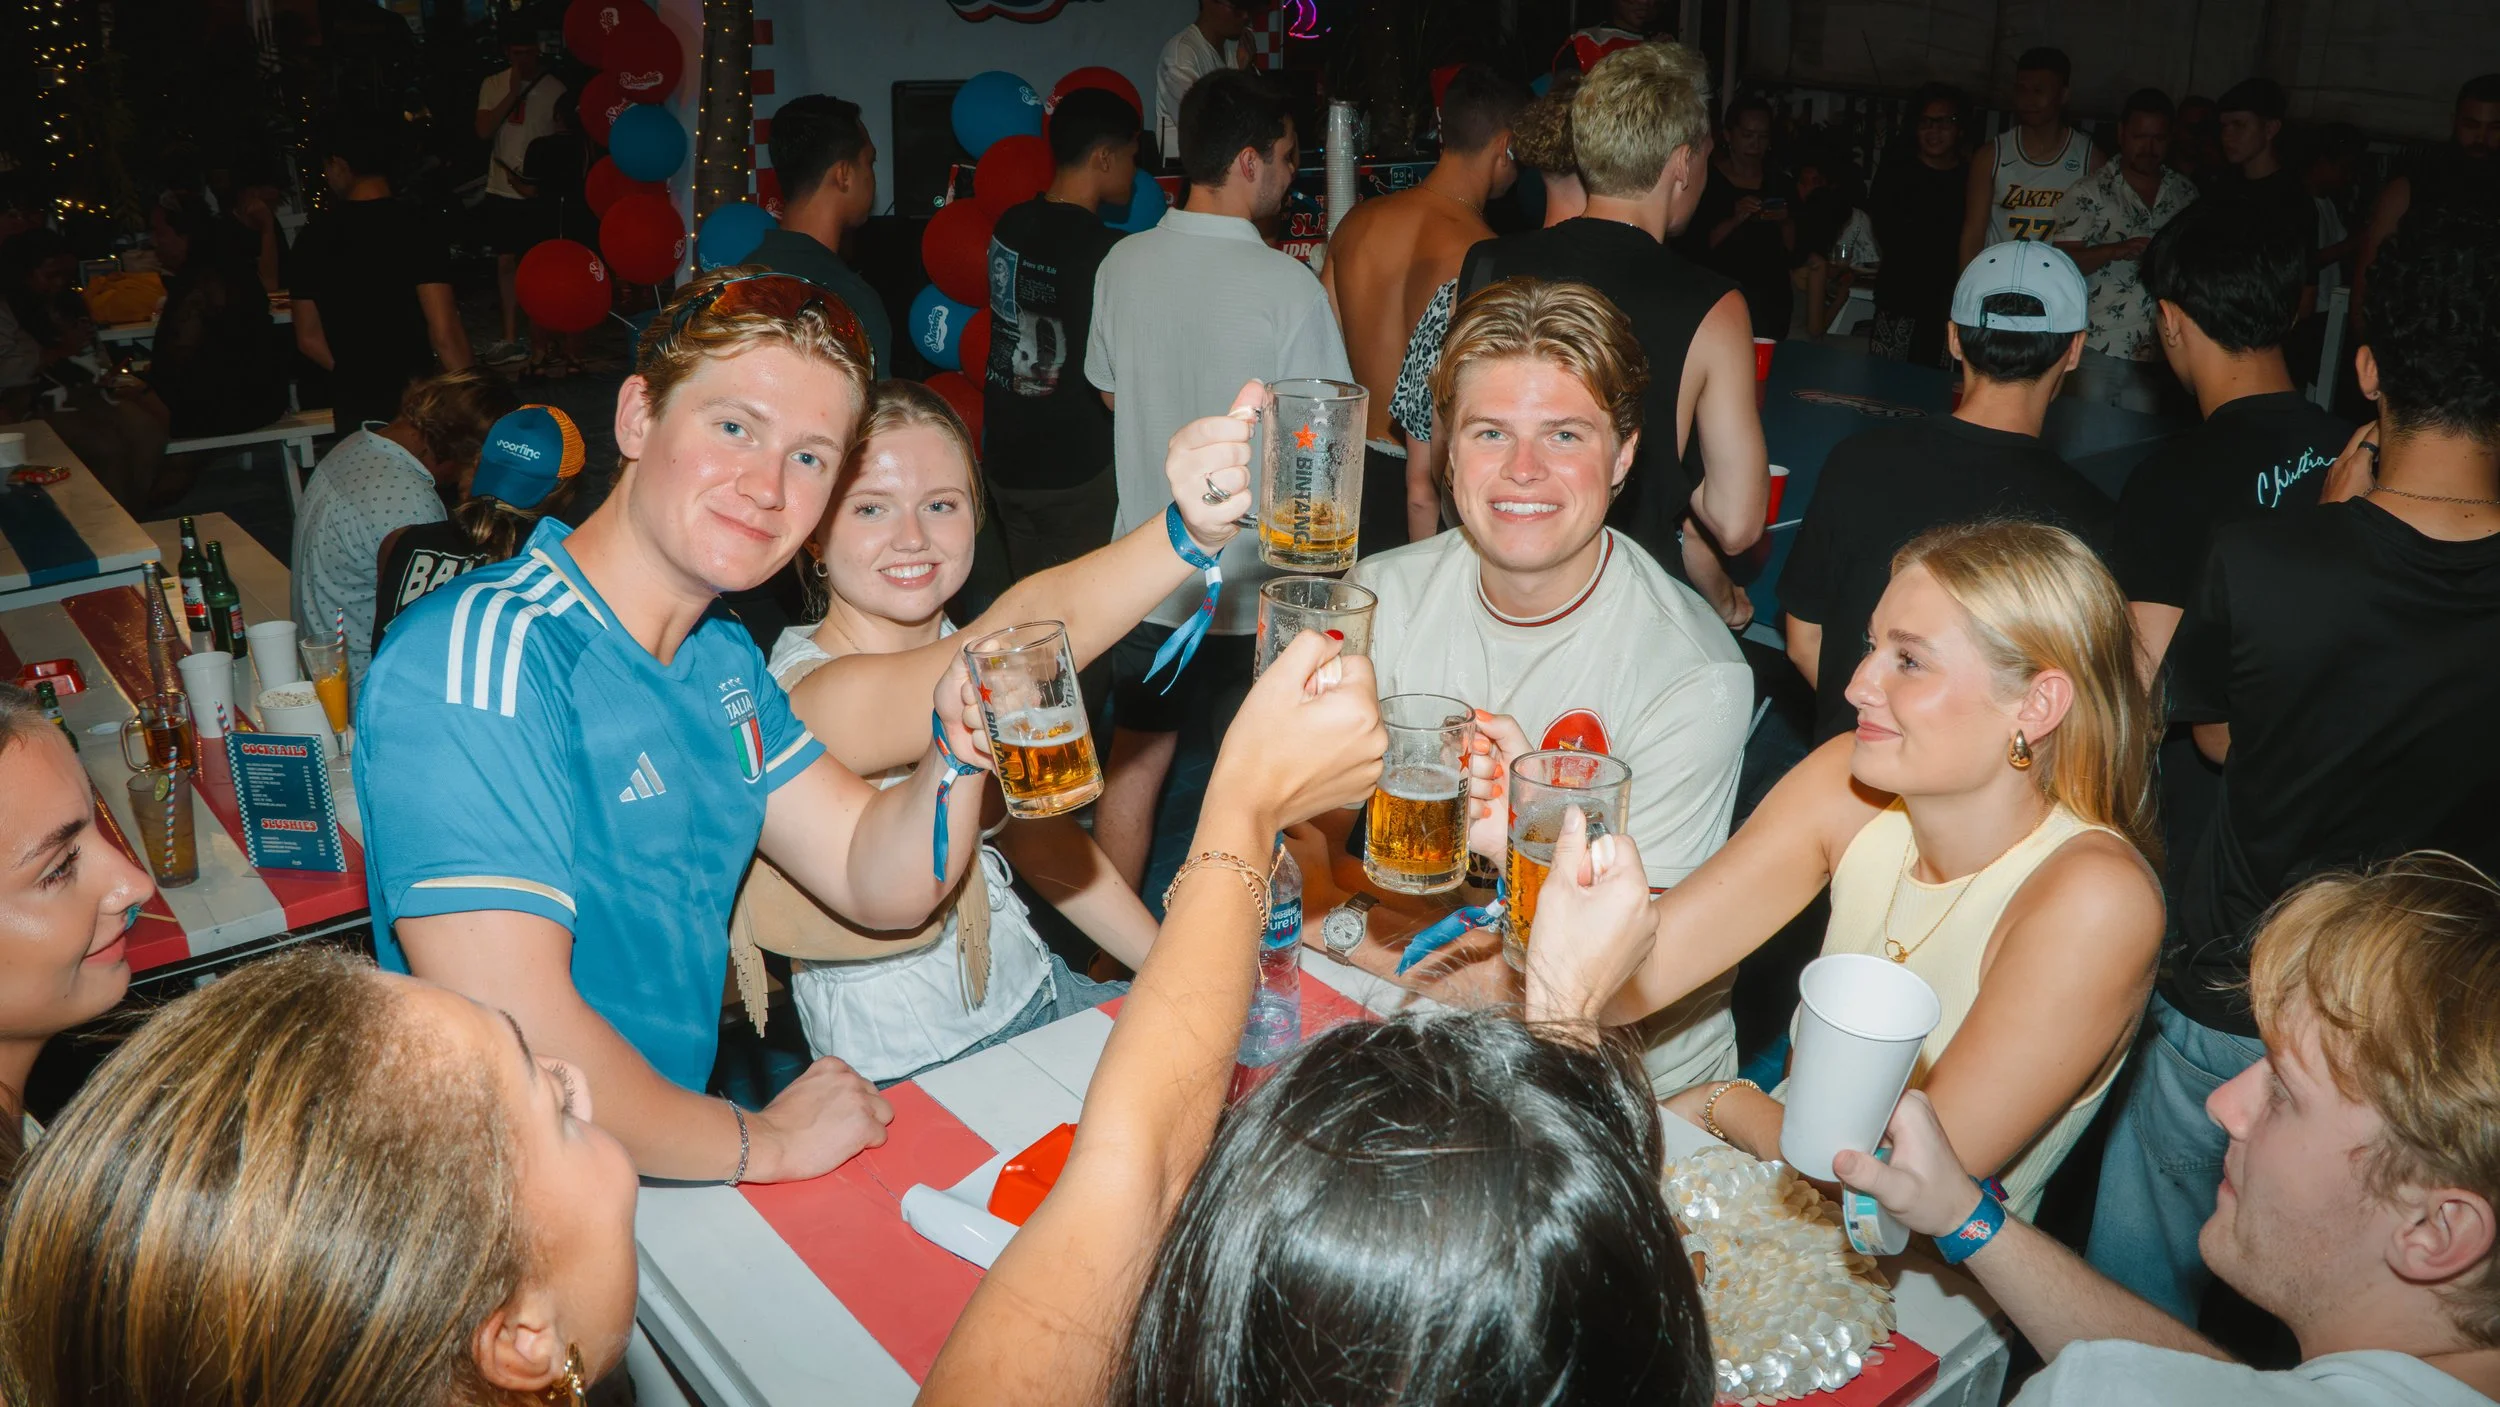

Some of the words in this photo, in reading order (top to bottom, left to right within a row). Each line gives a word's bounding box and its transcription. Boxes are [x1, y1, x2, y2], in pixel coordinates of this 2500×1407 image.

[2002, 184, 2064, 210] LAKER
[2008, 217, 2055, 241] 77
[2258, 447, 2338, 508] Christia
[1294, 456, 1313, 545] BINTANG
[401, 554, 488, 606] BA
[724, 695, 753, 720] TALIA
[242, 743, 308, 758] COCKTAILS
[985, 711, 1013, 794] BINTANG
[261, 818, 318, 832] SLUSHIES
[1269, 918, 1289, 930] ure
